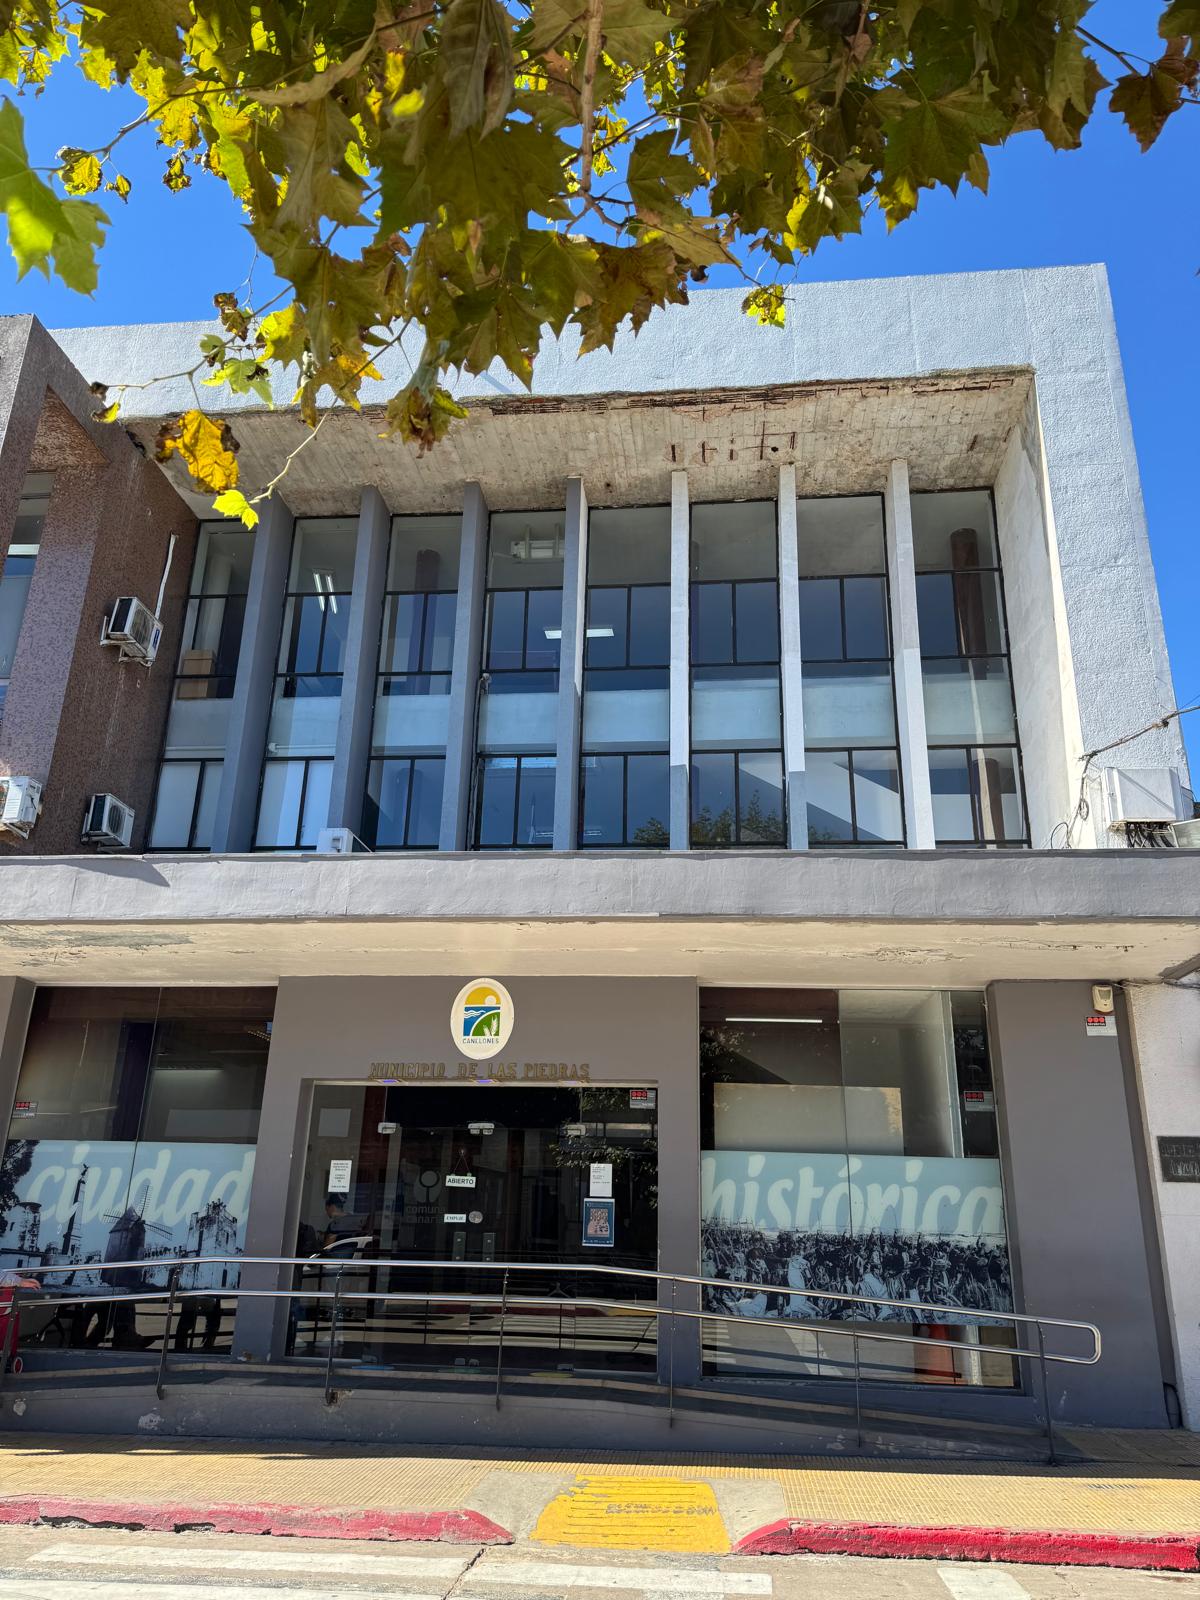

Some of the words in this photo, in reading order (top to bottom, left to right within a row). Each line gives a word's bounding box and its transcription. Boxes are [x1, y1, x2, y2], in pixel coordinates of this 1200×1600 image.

[370, 1062, 446, 1078] MUNICIPIO
[458, 1062, 479, 1078] DE
[488, 1062, 517, 1078] LAS
[524, 1063, 590, 1079] PIEDRAS
[25, 1143, 256, 1226] ciudad
[701, 1154, 1006, 1234] histórica
